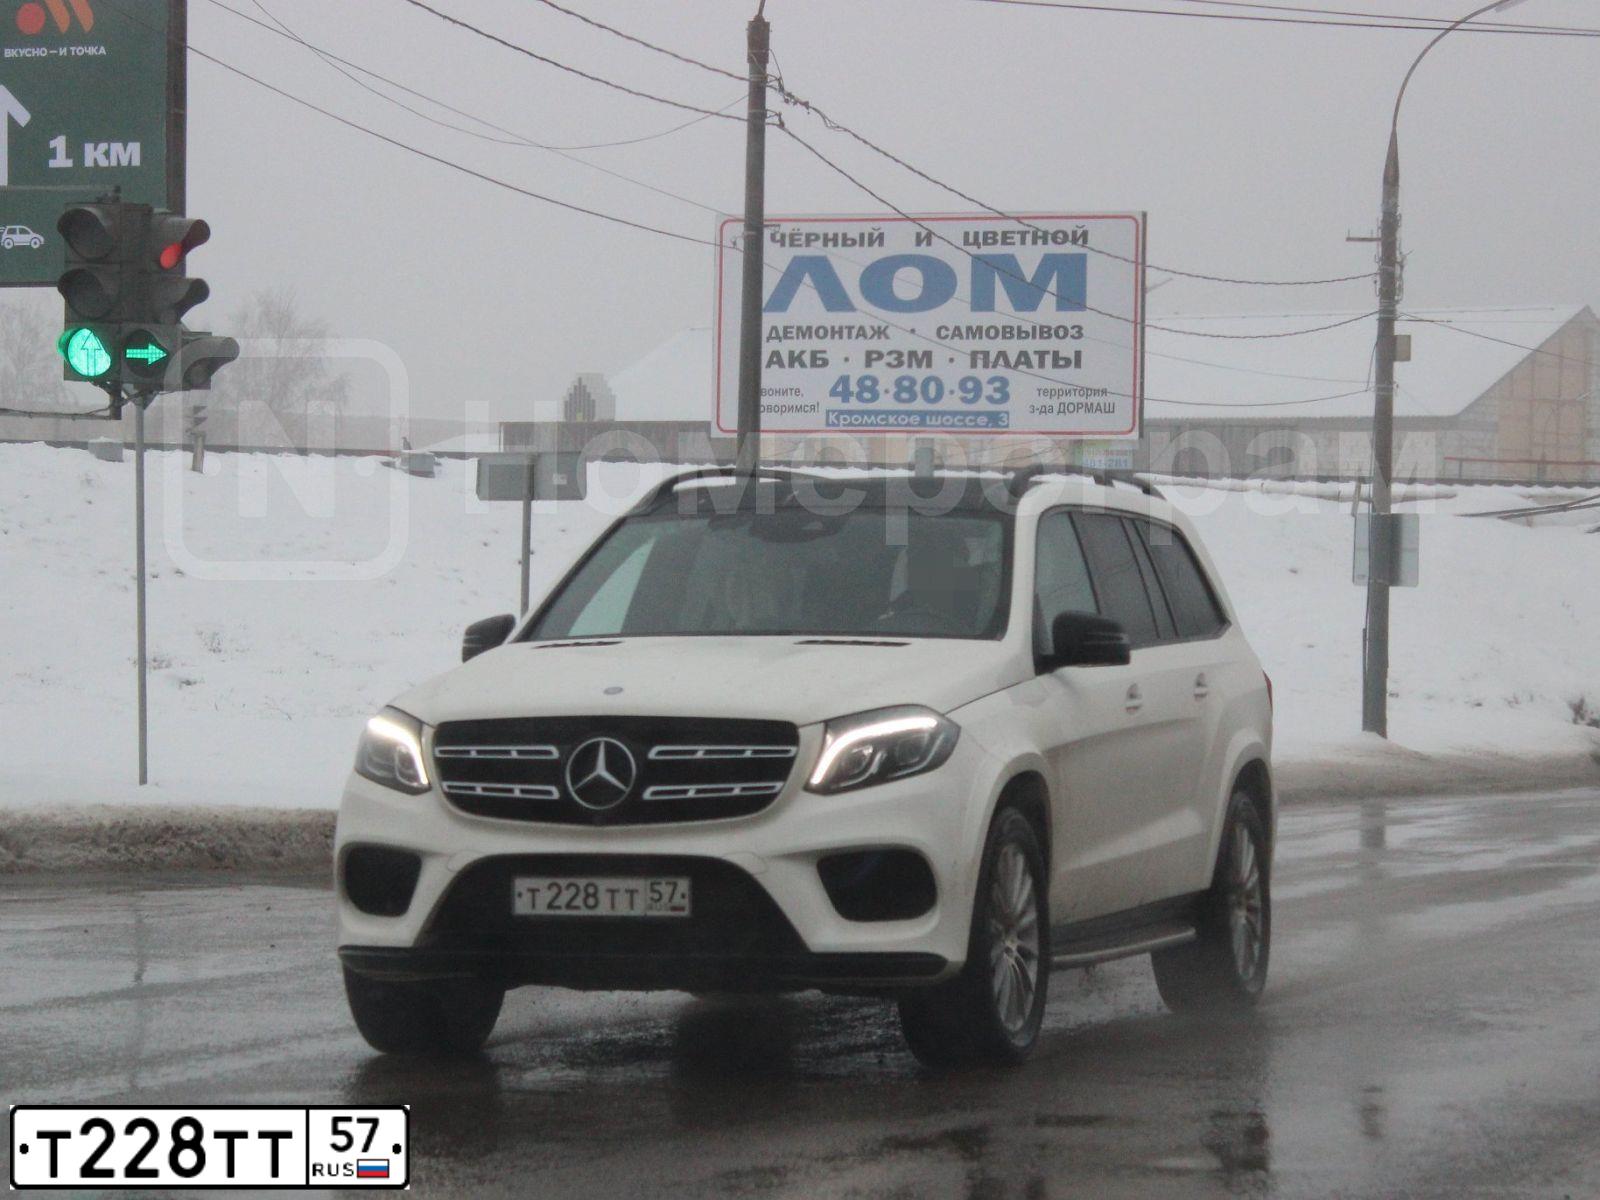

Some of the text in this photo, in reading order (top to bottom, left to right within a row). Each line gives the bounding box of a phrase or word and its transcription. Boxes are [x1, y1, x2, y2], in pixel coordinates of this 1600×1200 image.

[4, 47, 48, 58] ВКУСНО
[59, 48, 67, 56] И
[70, 46, 107, 56] ТОЧКА
[48, 135, 73, 168] 1
[770, 225, 1089, 249] ЧЁРНЫЙ И ЦВЕТНОЙ
[762, 252, 1088, 314] ЛОМ
[766, 324, 1084, 343] ДЕМОНТАЖ САМОВЫВОЗ
[765, 350, 830, 369] АКБ
[969, 350, 1083, 369] ПЛАТЫ
[760, 387, 804, 398] воните,
[1036, 387, 1108, 400] территория
[760, 402, 820, 415] оворимся!
[1029, 403, 1115, 415] з-да ДОРМАШ
[828, 411, 920, 428] Кромское
[650, 881, 678, 903] 57
